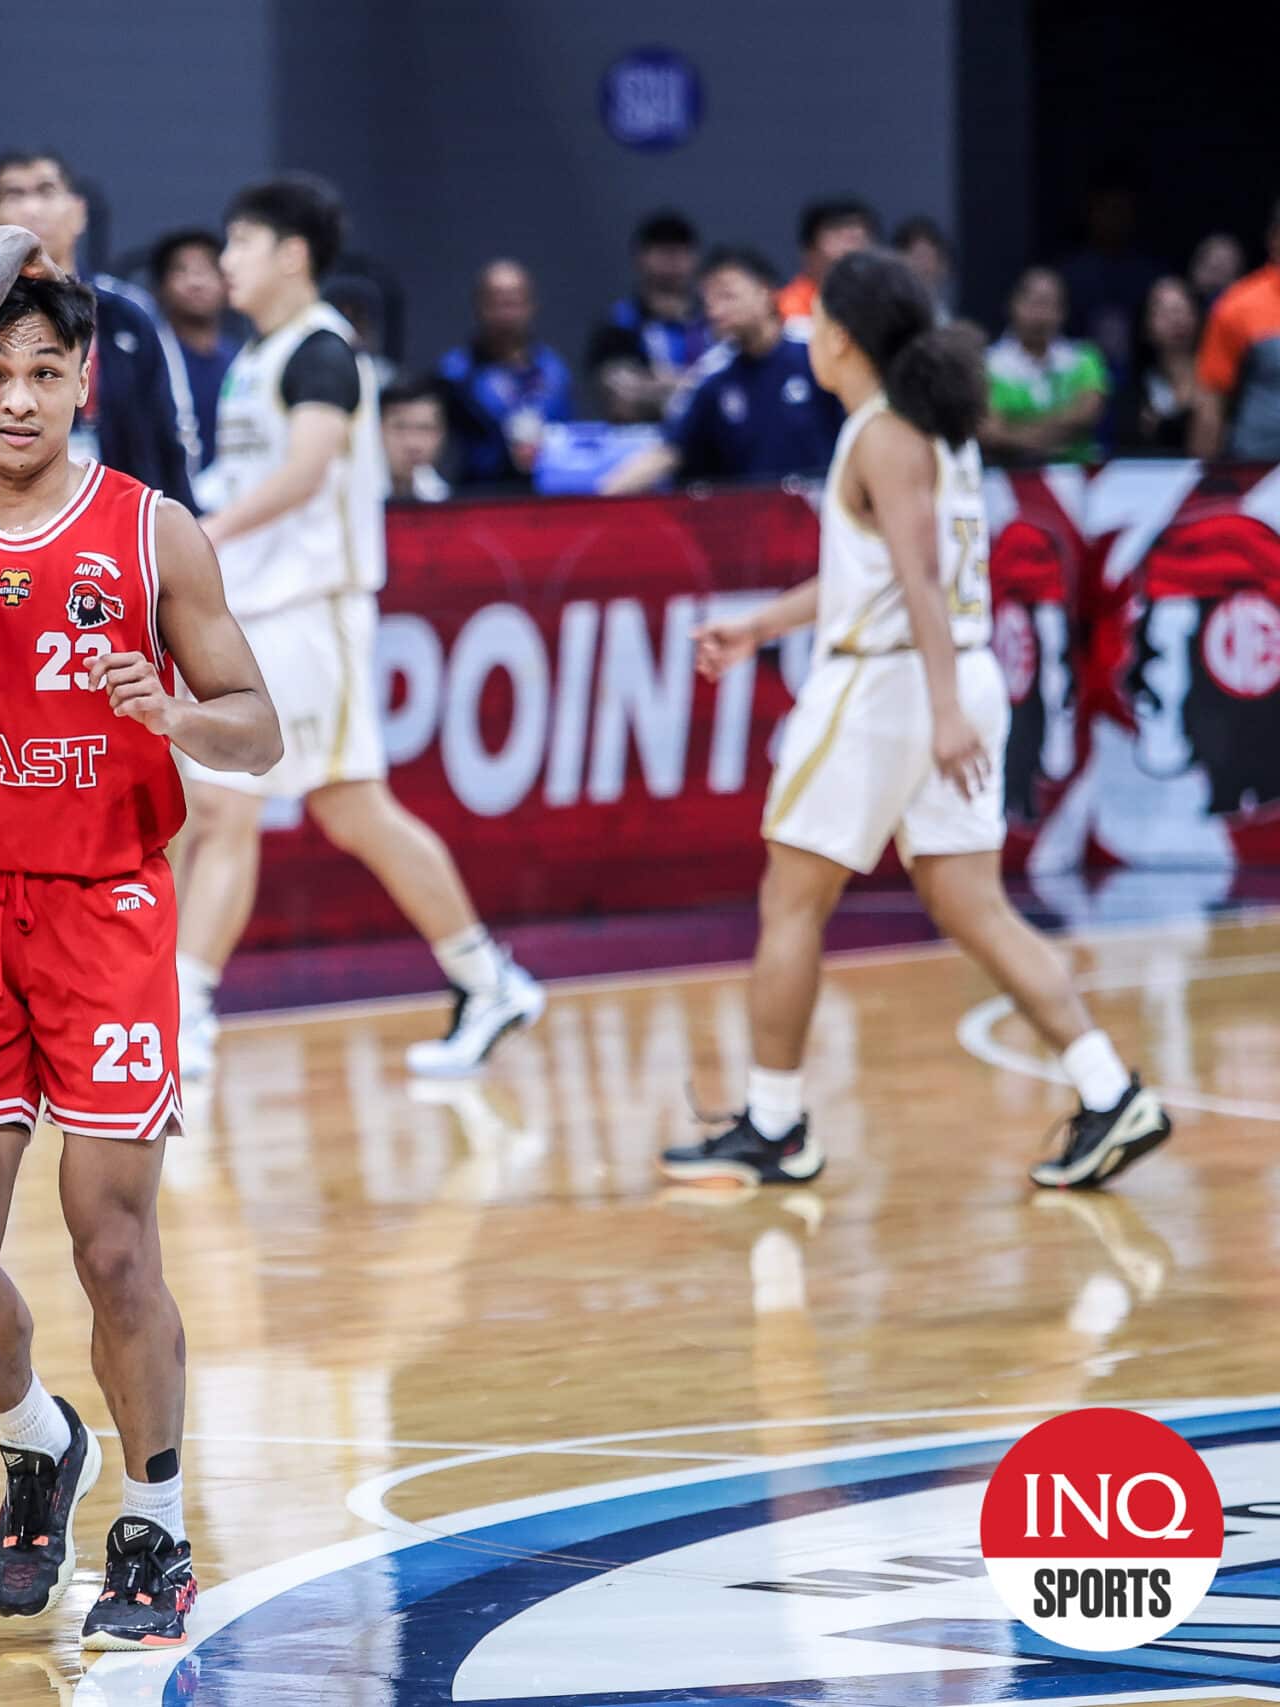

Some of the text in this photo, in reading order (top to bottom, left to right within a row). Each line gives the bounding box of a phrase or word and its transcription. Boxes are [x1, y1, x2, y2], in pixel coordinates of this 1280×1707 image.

[74, 563, 103, 578] ANTA
[35, 631, 112, 691] 23
[116, 896, 141, 912] ANTA
[92, 1022, 164, 1082] 23
